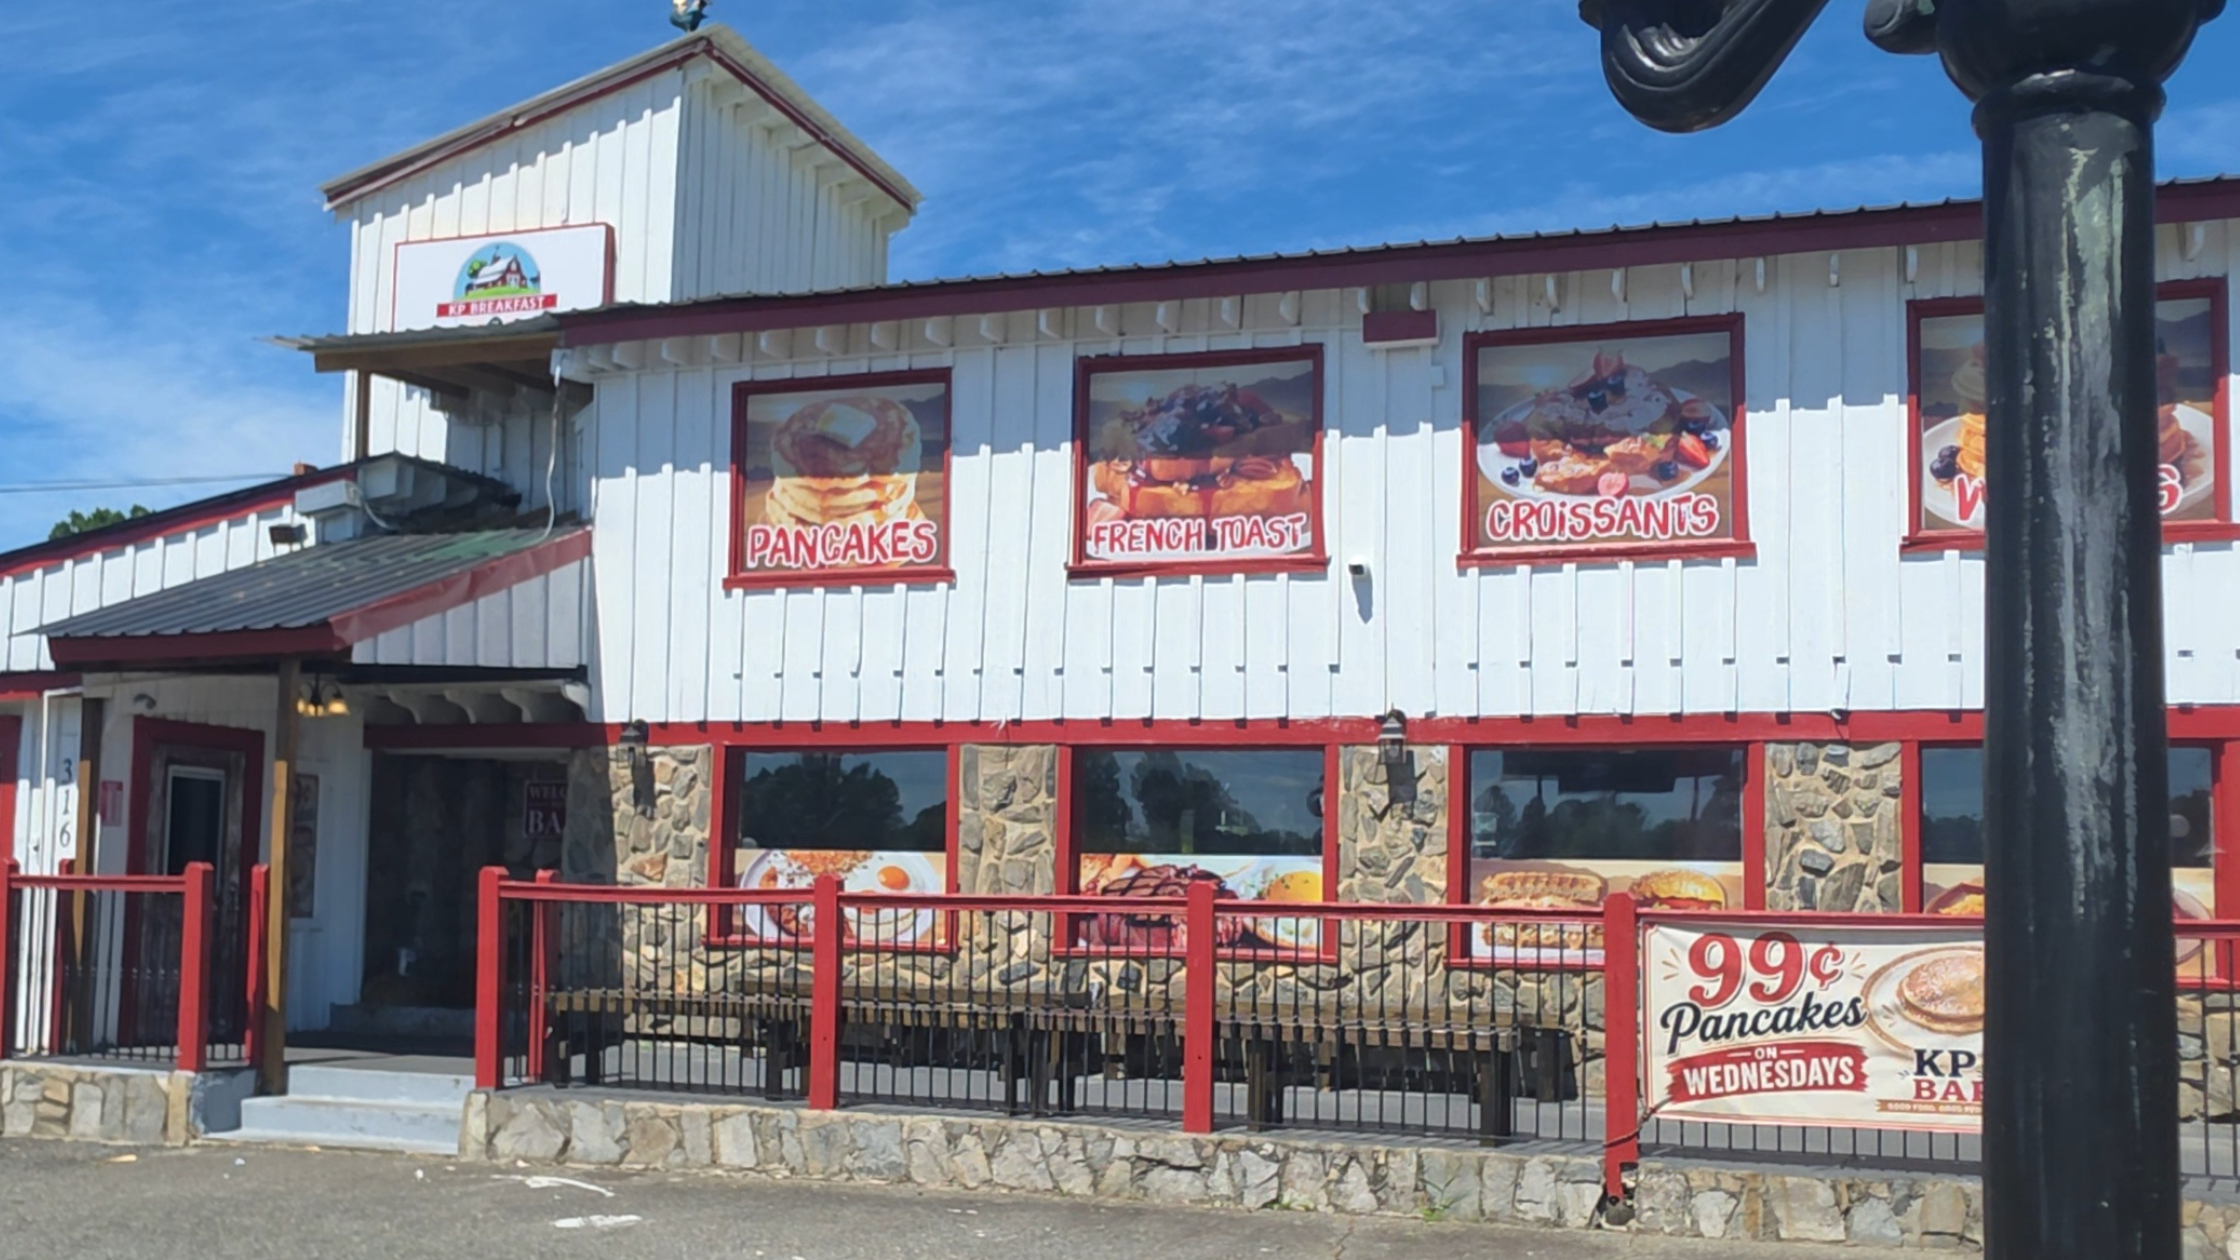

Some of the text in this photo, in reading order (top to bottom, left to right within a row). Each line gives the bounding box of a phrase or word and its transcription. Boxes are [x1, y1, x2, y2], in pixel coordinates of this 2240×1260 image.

[448, 296, 544, 316] KP BREAKFAST
[748, 521, 936, 568] PANCAKES
[1093, 513, 1307, 554] FRENCH TOAST
[59, 757, 73, 848] 316
[1688, 931, 1844, 1007] 99¢
[1660, 991, 1868, 1055] Pancakes
[1754, 1046, 1777, 1060] ON
[1913, 1048, 1977, 1078] KP
[1683, 1056, 1855, 1096] WEDNESDAYS
